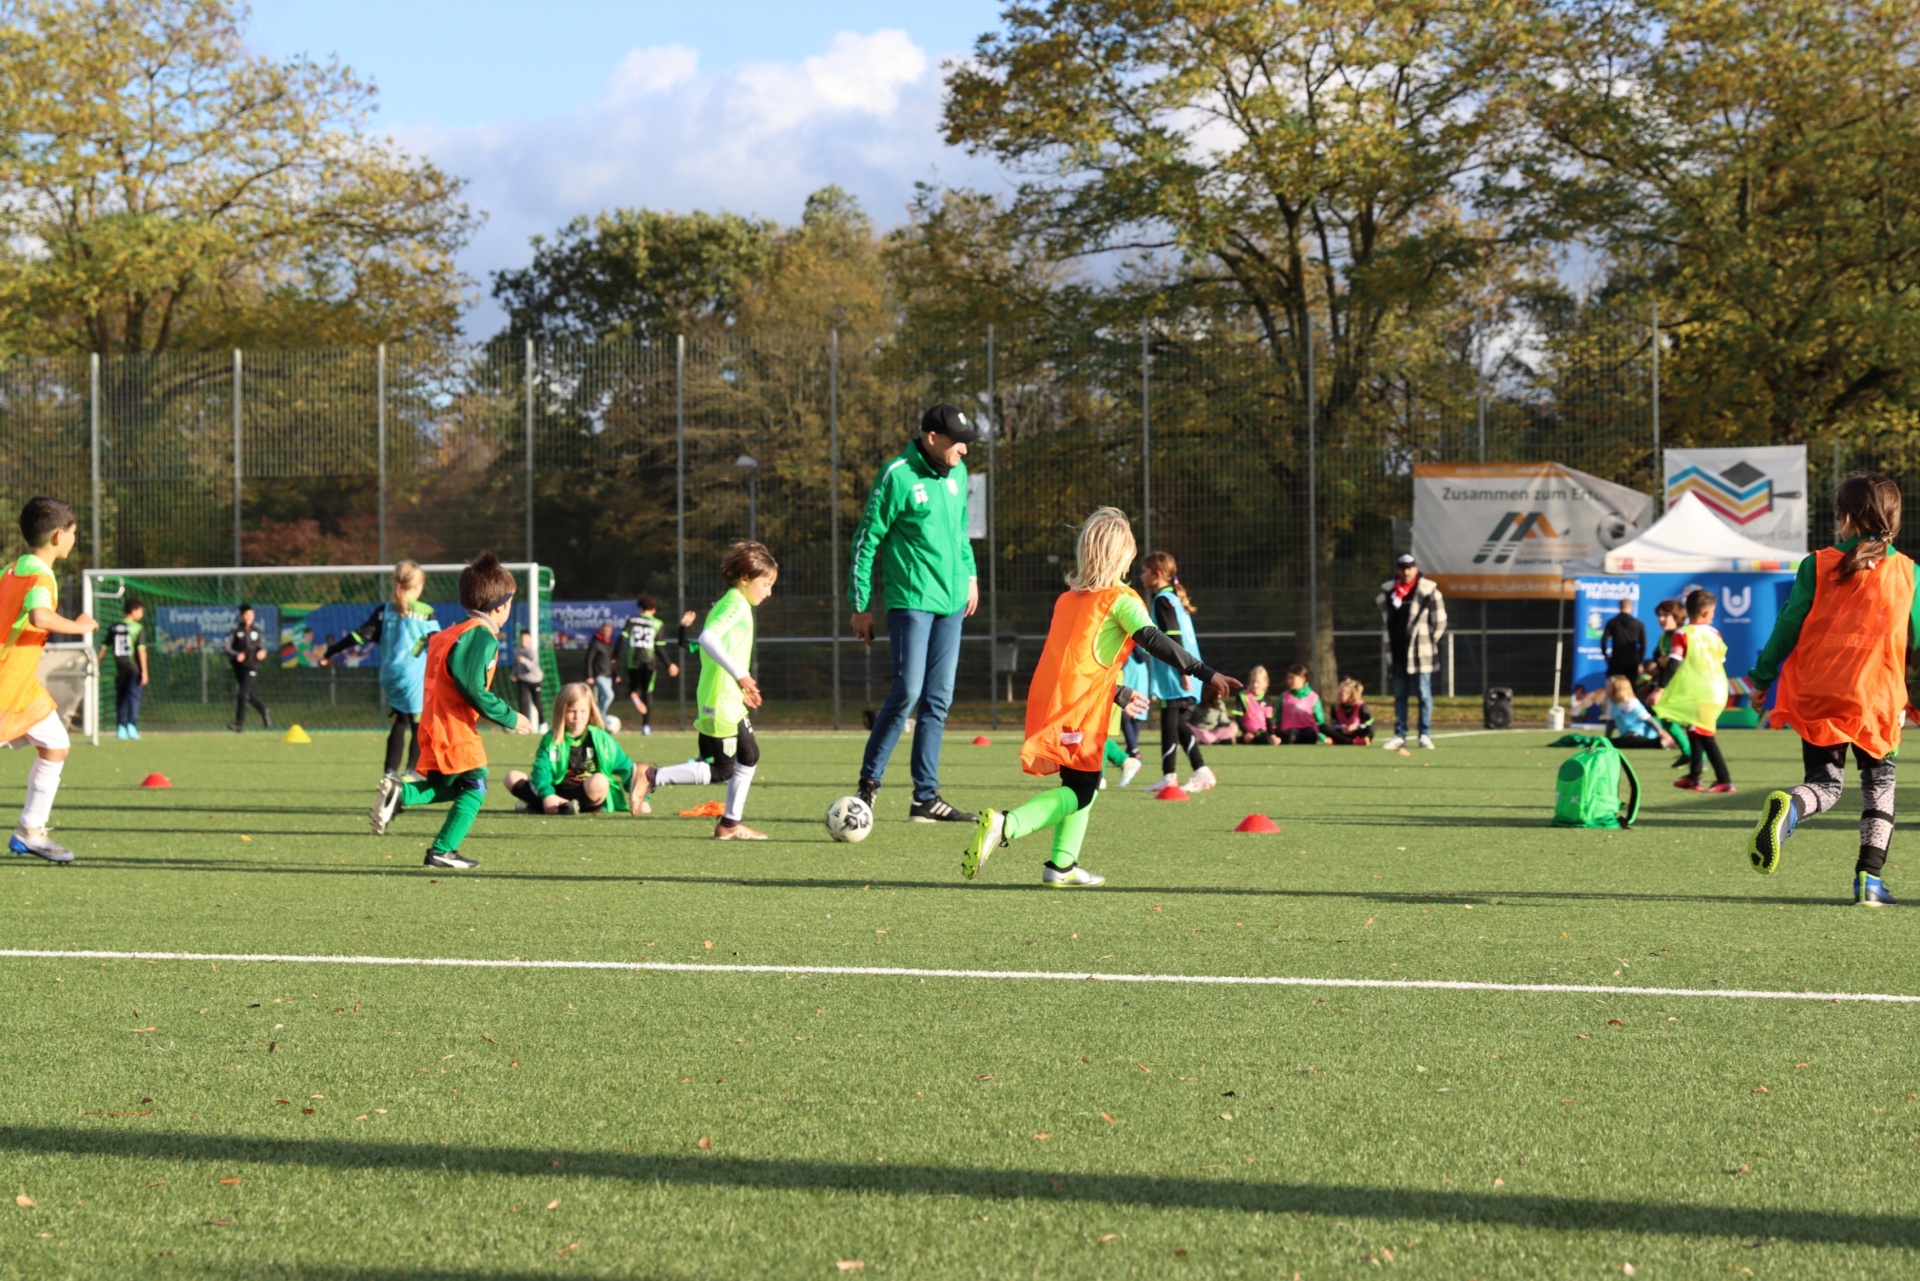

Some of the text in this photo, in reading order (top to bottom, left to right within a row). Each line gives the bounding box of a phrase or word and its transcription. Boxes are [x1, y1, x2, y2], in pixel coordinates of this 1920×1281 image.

[1442, 487, 1528, 501] Zusammen
[1535, 489, 1567, 501] zum
[630, 625, 656, 649] 23
